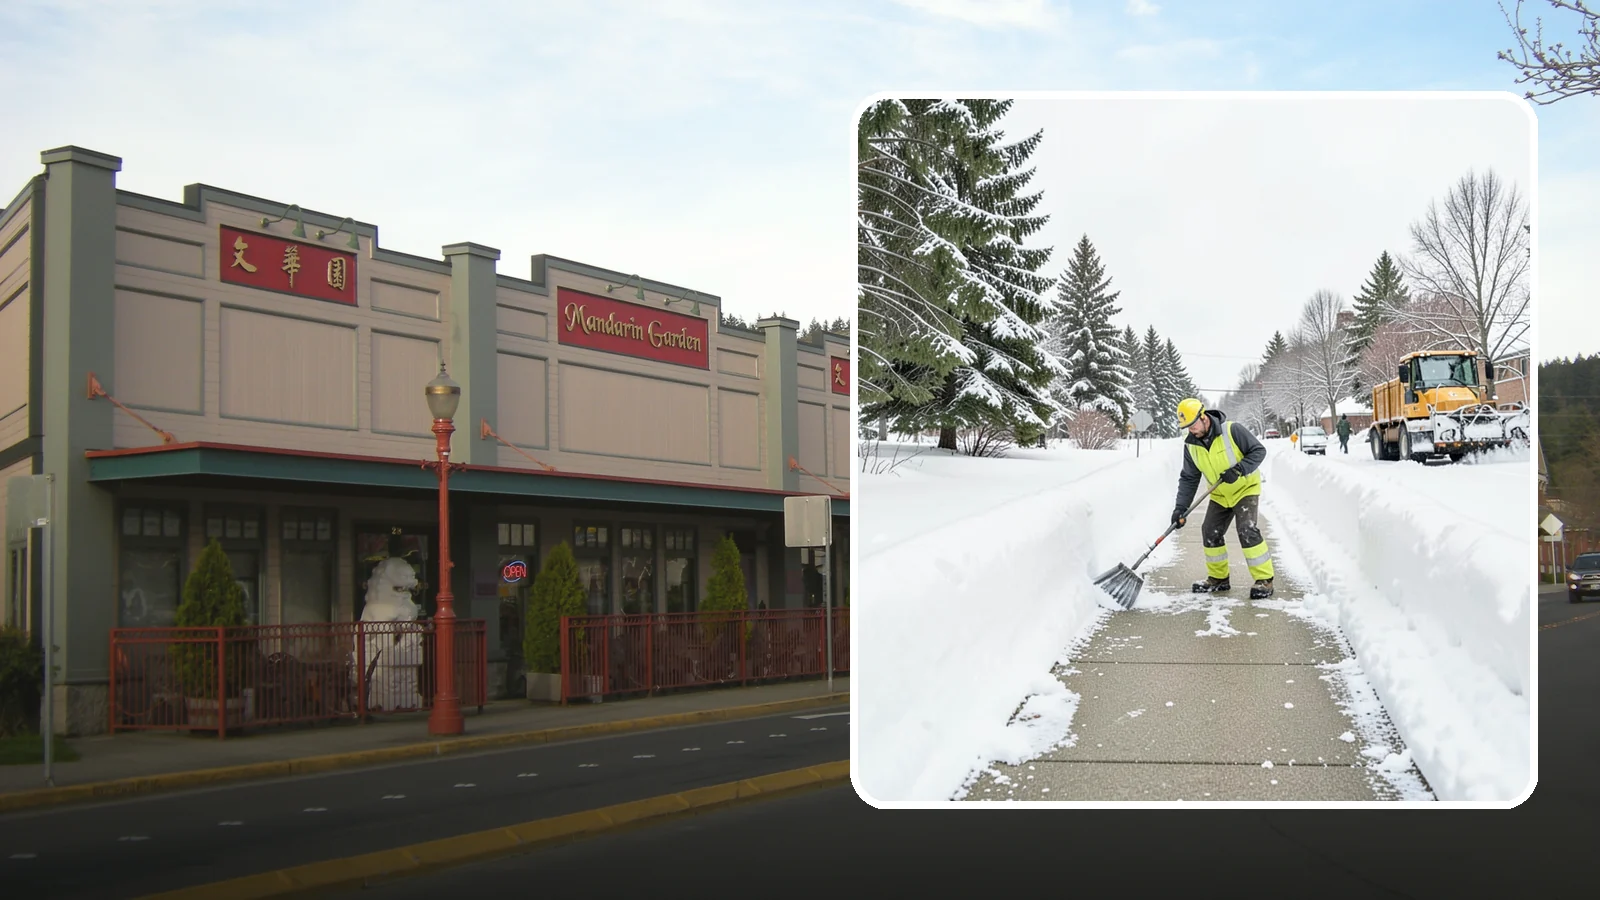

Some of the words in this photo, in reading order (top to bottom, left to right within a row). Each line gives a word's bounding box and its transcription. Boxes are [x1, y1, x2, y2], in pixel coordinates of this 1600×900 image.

[564, 302, 644, 341] Mandarin
[648, 320, 701, 352] Garden
[503, 565, 527, 578] OPEN
